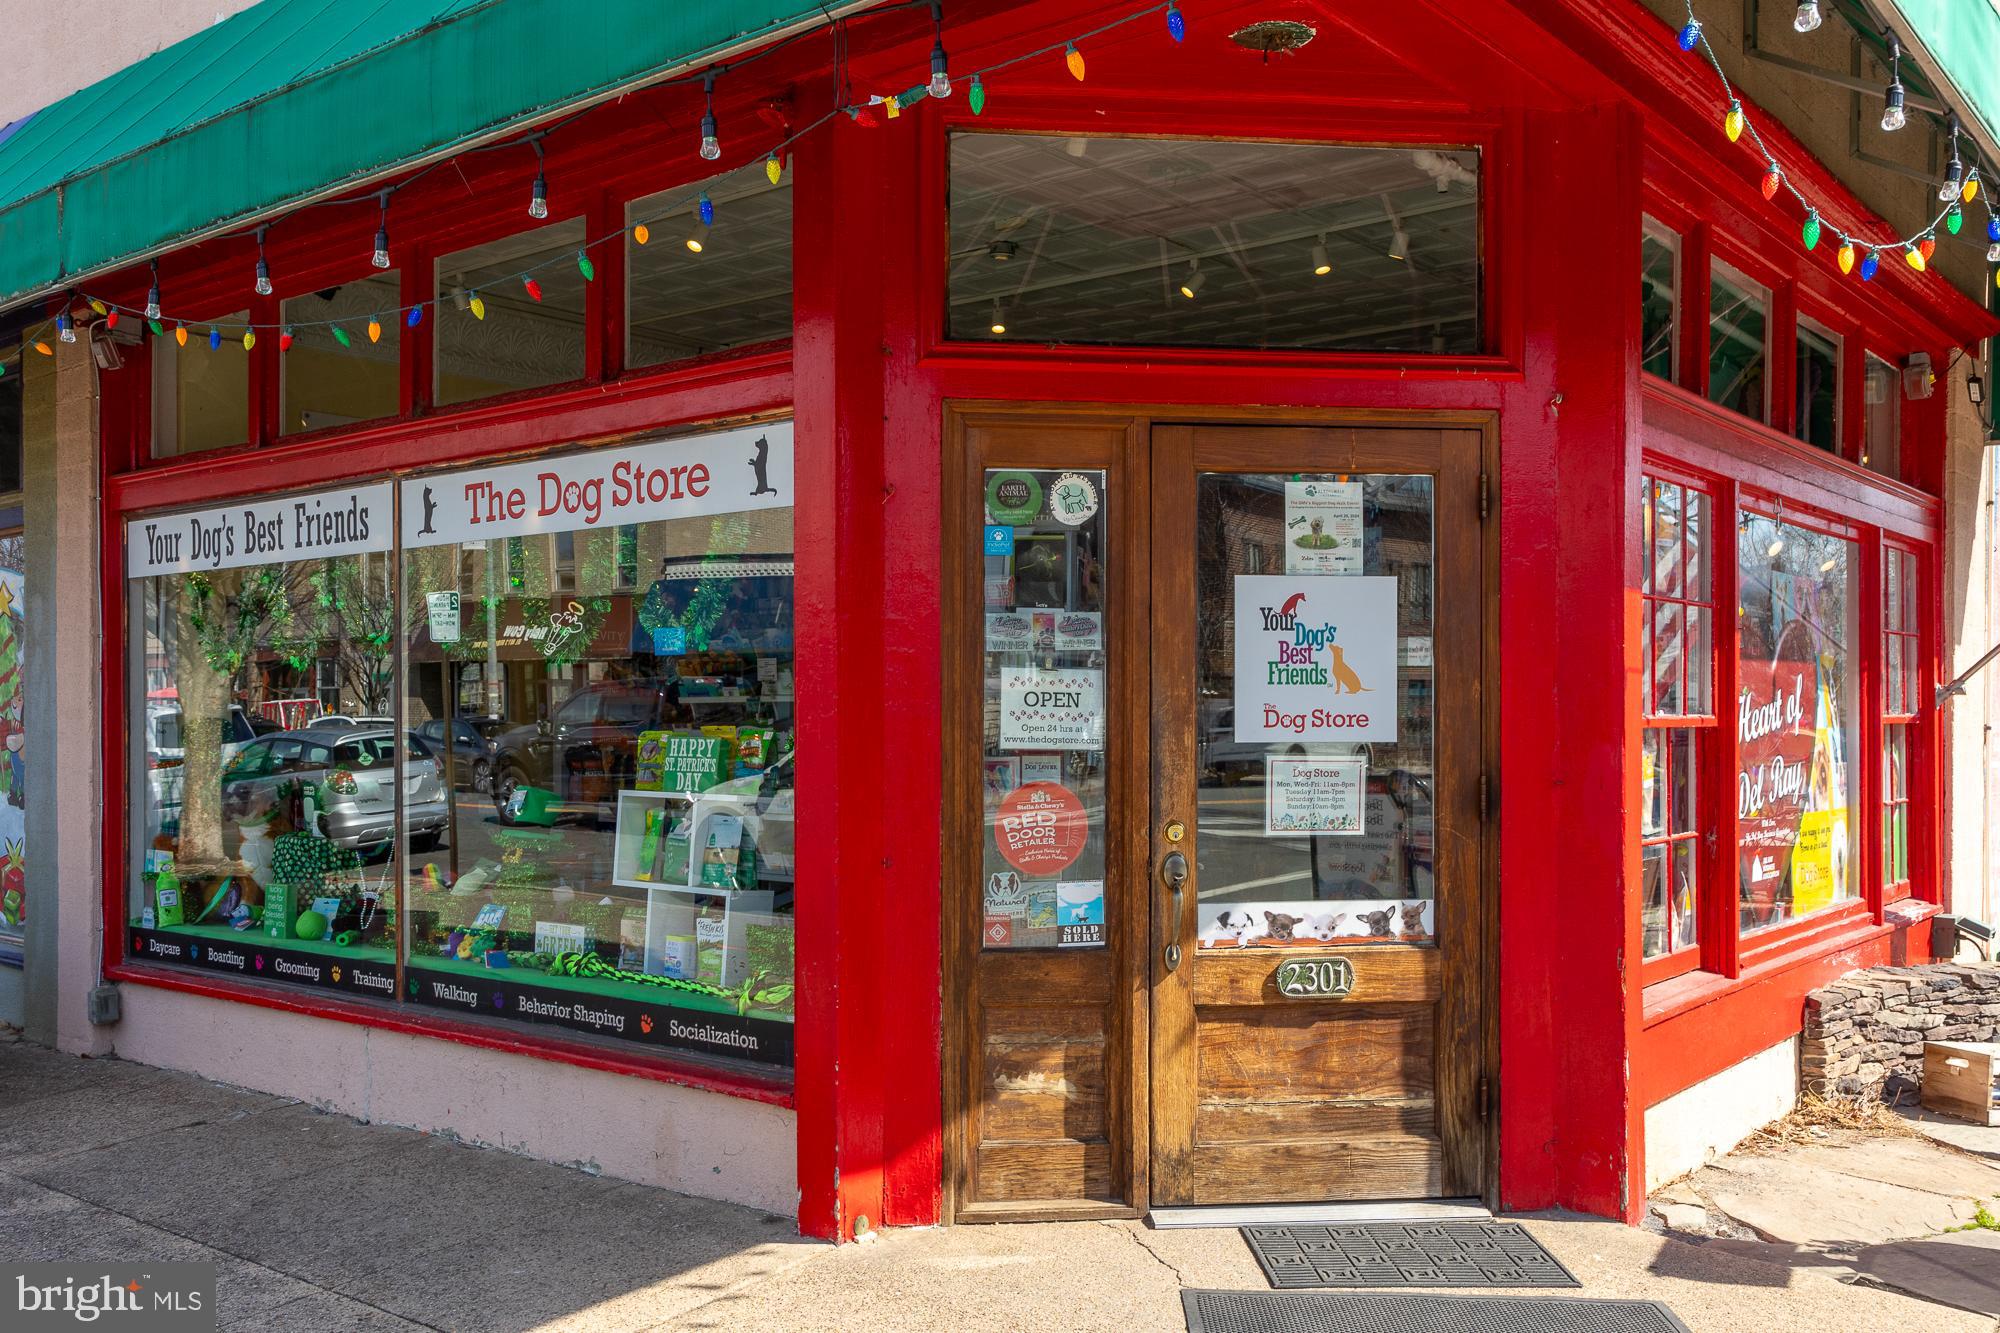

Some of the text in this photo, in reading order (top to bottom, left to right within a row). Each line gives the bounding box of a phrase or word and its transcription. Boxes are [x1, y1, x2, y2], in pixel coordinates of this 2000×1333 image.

[465, 461, 710, 525] The Dog Store
[145, 496, 370, 567] Your Dog's Best Friends
[1260, 607, 1297, 631] Your
[992, 640, 1028, 650] WINNER
[1063, 639, 1096, 648] WINNER
[1294, 622, 1337, 652] Dog's
[1278, 640, 1313, 664] Best
[1267, 661, 1328, 686] Friends
[1024, 691, 1081, 708] OPEN
[1739, 673, 1803, 744] Heart of
[1021, 724, 1045, 733] Open
[1263, 709, 1369, 733] Dog Store
[669, 738, 716, 758] HAPPY
[1004, 736, 1100, 745] www.thedogstore.com
[664, 757, 717, 772] ST. PATRICK'S
[1293, 768, 1340, 779] Dog Store
[675, 772, 702, 791] DAY
[1739, 755, 1803, 820] Del Ray
[1002, 811, 1057, 832] RED
[1007, 827, 1056, 843] DOOR
[1010, 837, 1056, 850] RETAILER
[986, 897, 1027, 907] Natural
[1062, 933, 1100, 942] HERE
[1064, 925, 1099, 934] SOLD
[543, 936, 577, 954] GREEN
[1285, 961, 1351, 994] 2301
[150, 939, 759, 1050] Daycare Boarding Grooming Training Walking Behavior Shaping Socialization
